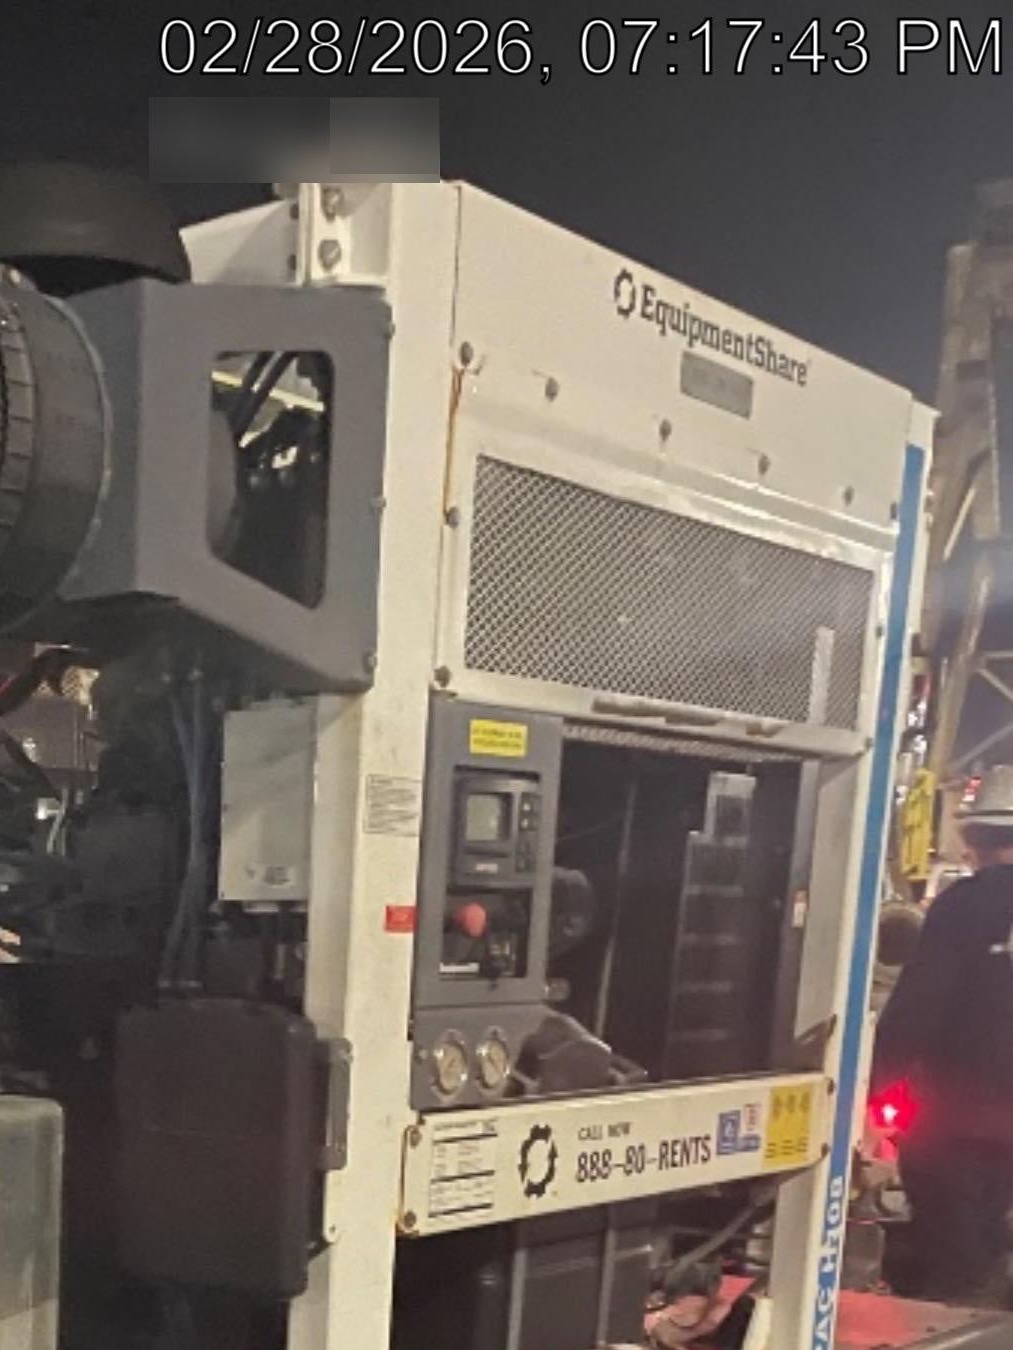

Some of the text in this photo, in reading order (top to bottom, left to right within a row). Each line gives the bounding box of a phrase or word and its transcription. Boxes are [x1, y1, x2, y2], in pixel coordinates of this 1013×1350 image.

[640, 283, 809, 387] EquipmentShare
[578, 1121, 631, 1141] CALL NOW
[576, 1135, 711, 1182] 888-80-RENTS
